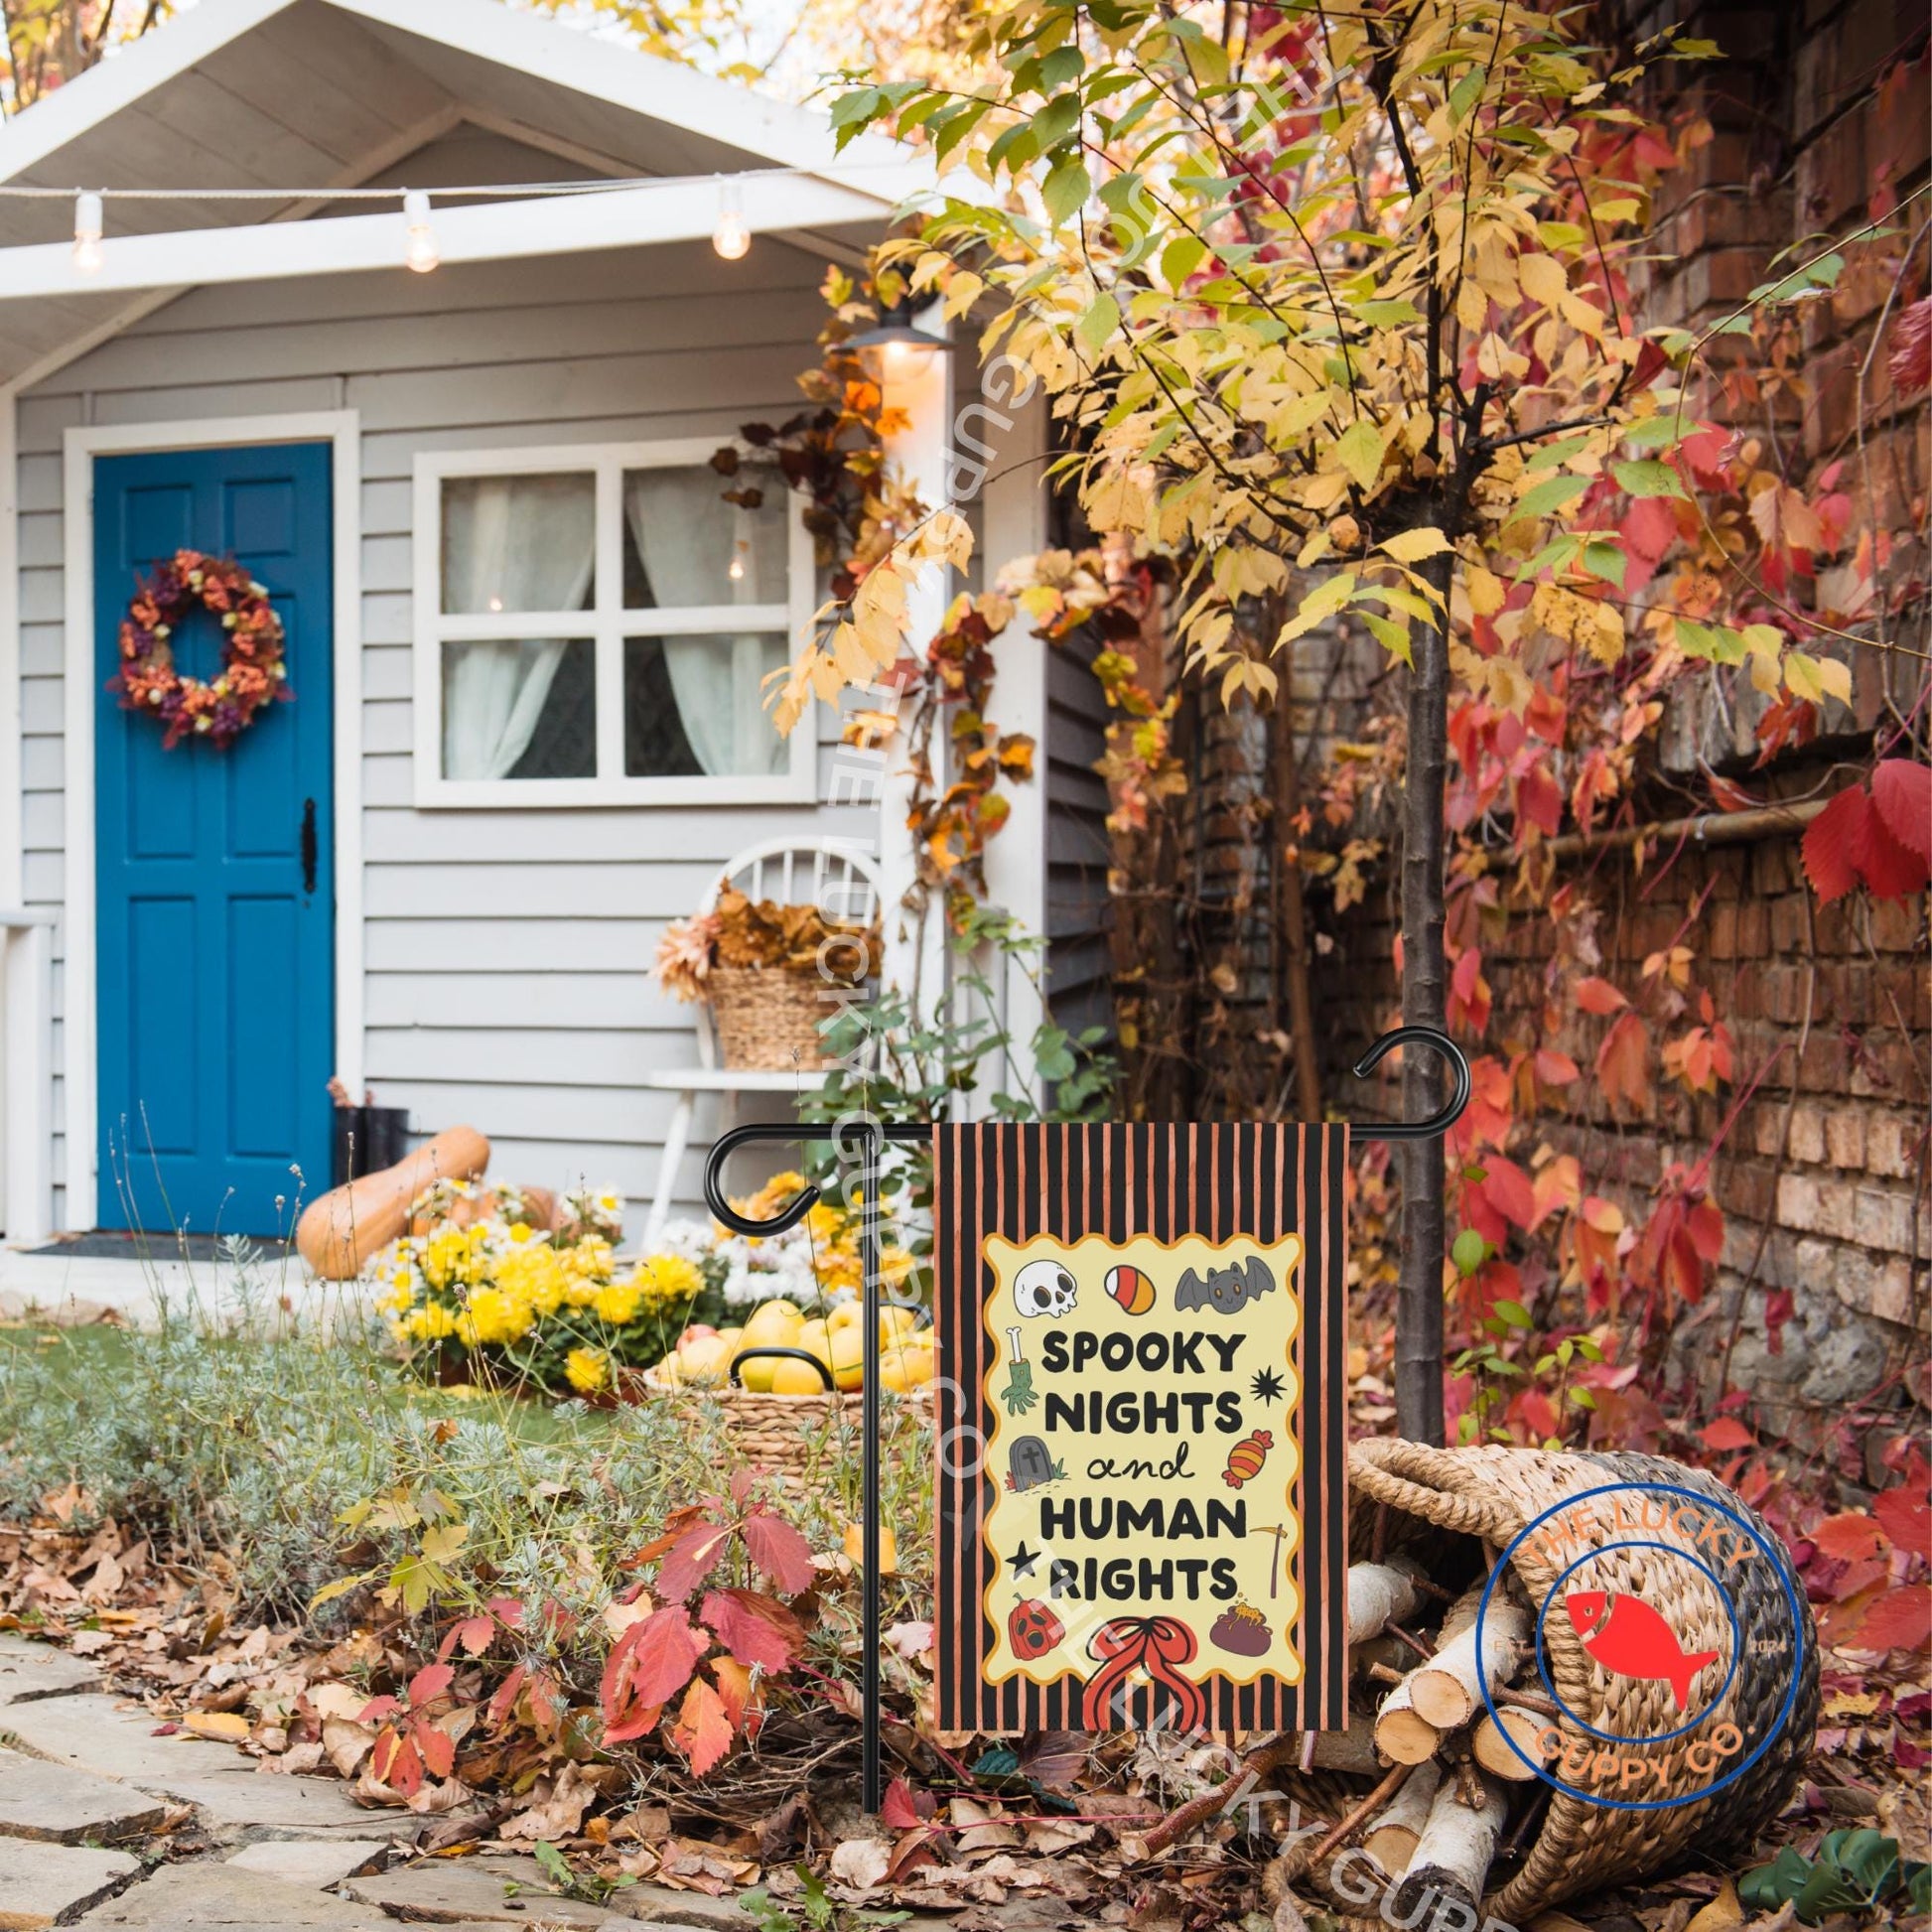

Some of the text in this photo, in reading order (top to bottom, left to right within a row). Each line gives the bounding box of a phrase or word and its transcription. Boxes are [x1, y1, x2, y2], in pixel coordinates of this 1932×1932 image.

[1040, 1330, 1247, 1374] SPOOKY
[1044, 1391, 1243, 1435] NIGHTS
[1086, 1441, 1195, 1480] and
[1040, 1497, 1247, 1541] HUMAN
[1049, 1558, 1238, 1601] RIGHTS
